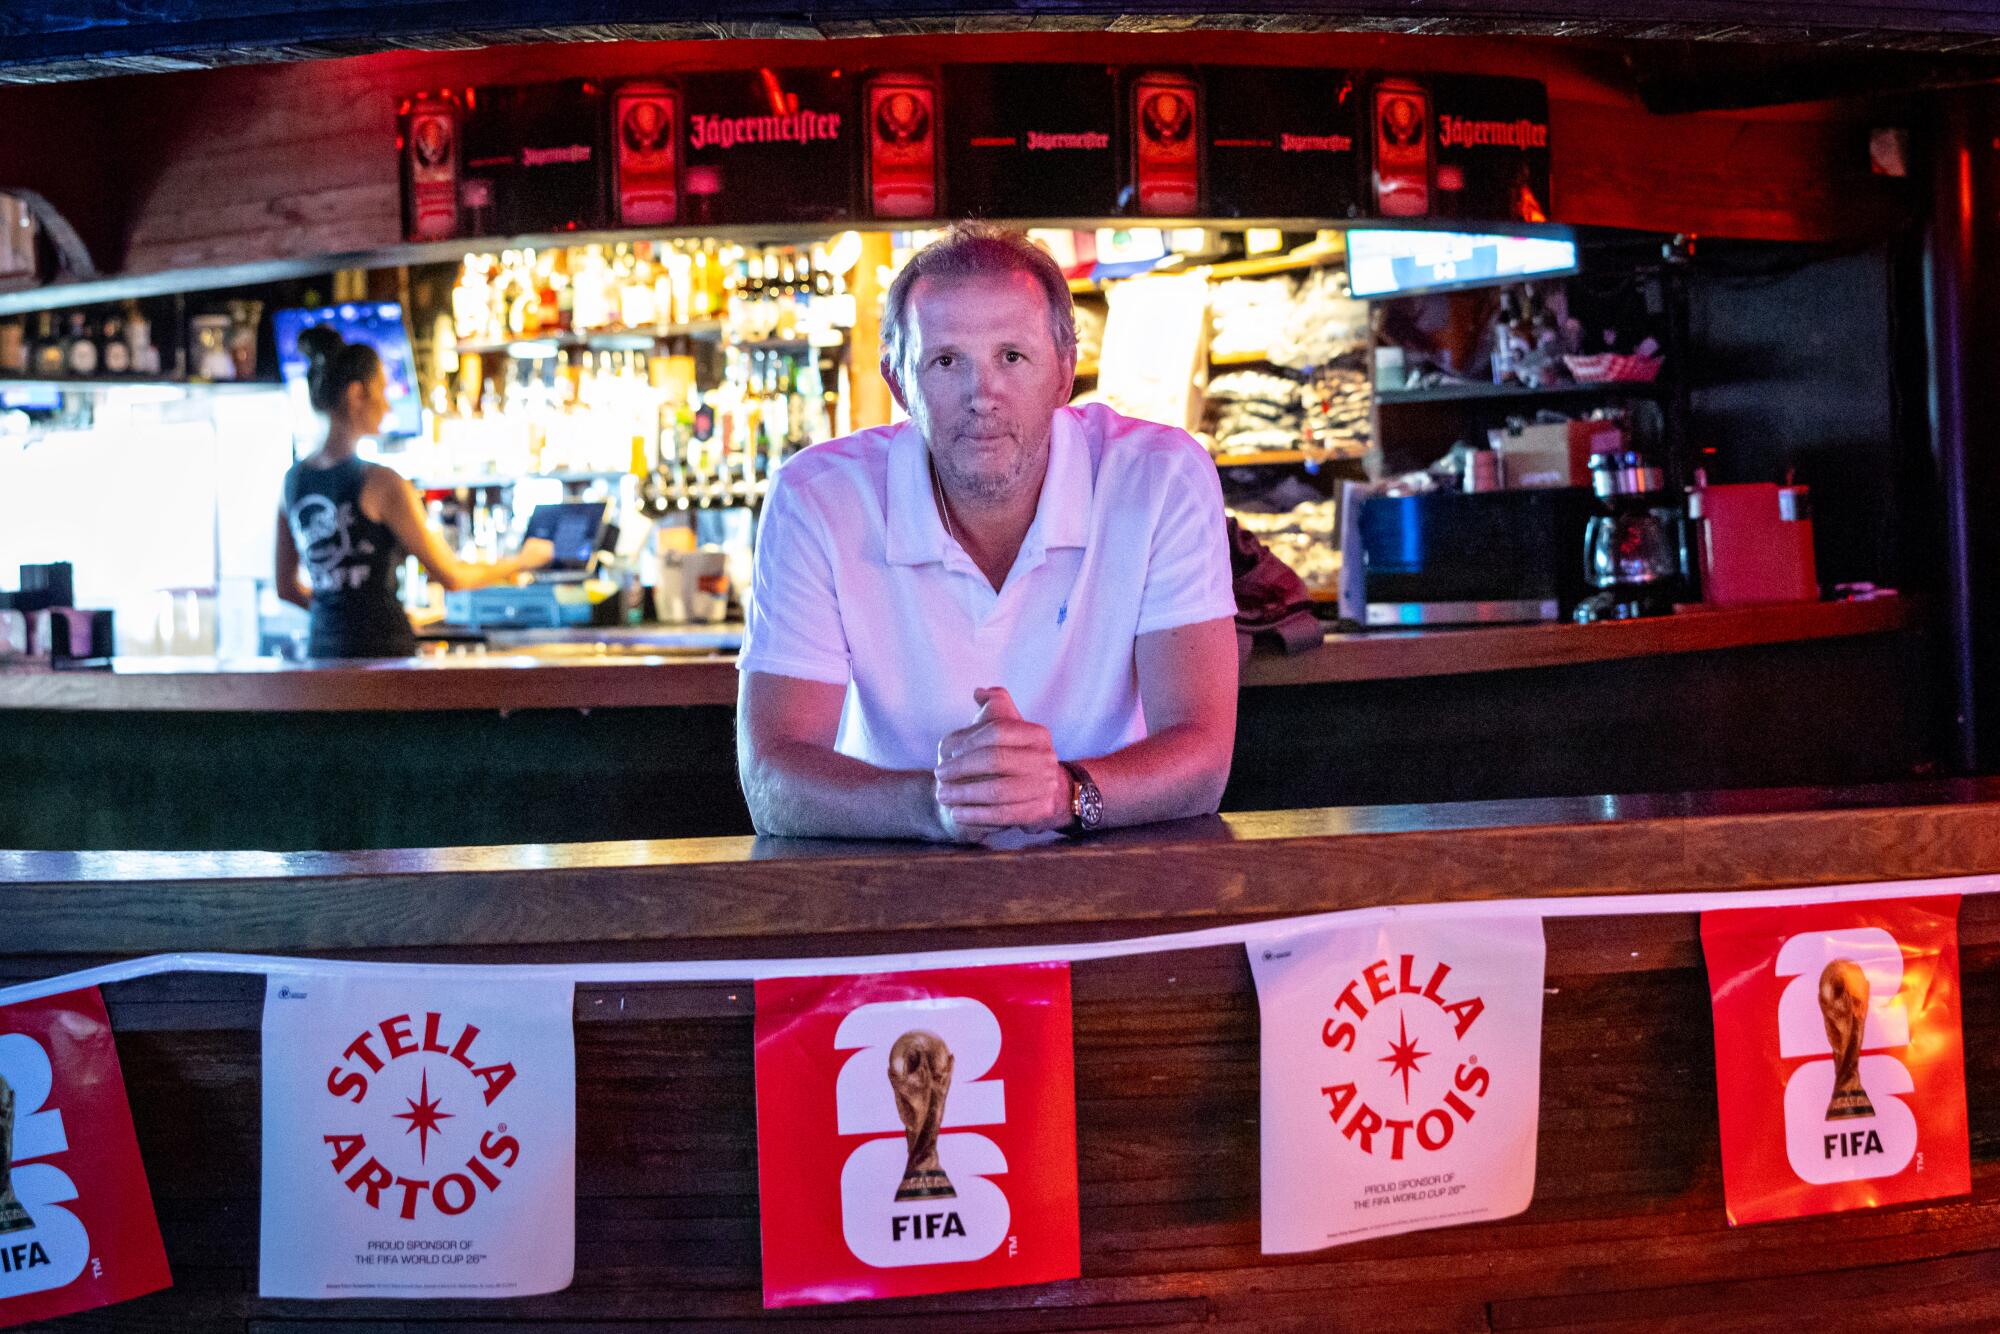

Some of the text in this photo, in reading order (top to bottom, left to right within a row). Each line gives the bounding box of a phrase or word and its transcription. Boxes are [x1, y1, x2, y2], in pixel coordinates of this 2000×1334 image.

[1322, 954, 1485, 1053] STELLA
[327, 1011, 517, 1107] STELLA
[1824, 1129, 1884, 1159] FIFA
[1354, 1199, 1370, 1210] THE
[1372, 1196, 1391, 1207] FIFA
[1393, 1190, 1426, 1203] WORLD
[1428, 1187, 1446, 1199] CUP
[1364, 1173, 1455, 1195] PROUD SPONSOR OF
[891, 1212, 966, 1241] FIFA
[0, 1241, 51, 1273] IFA
[355, 1254, 374, 1265] THE
[377, 1254, 398, 1265] FIFA
[401, 1254, 439, 1265] WORLD
[441, 1254, 463, 1265] CUP
[368, 1240, 472, 1250] PROUD SPONSOR OF
